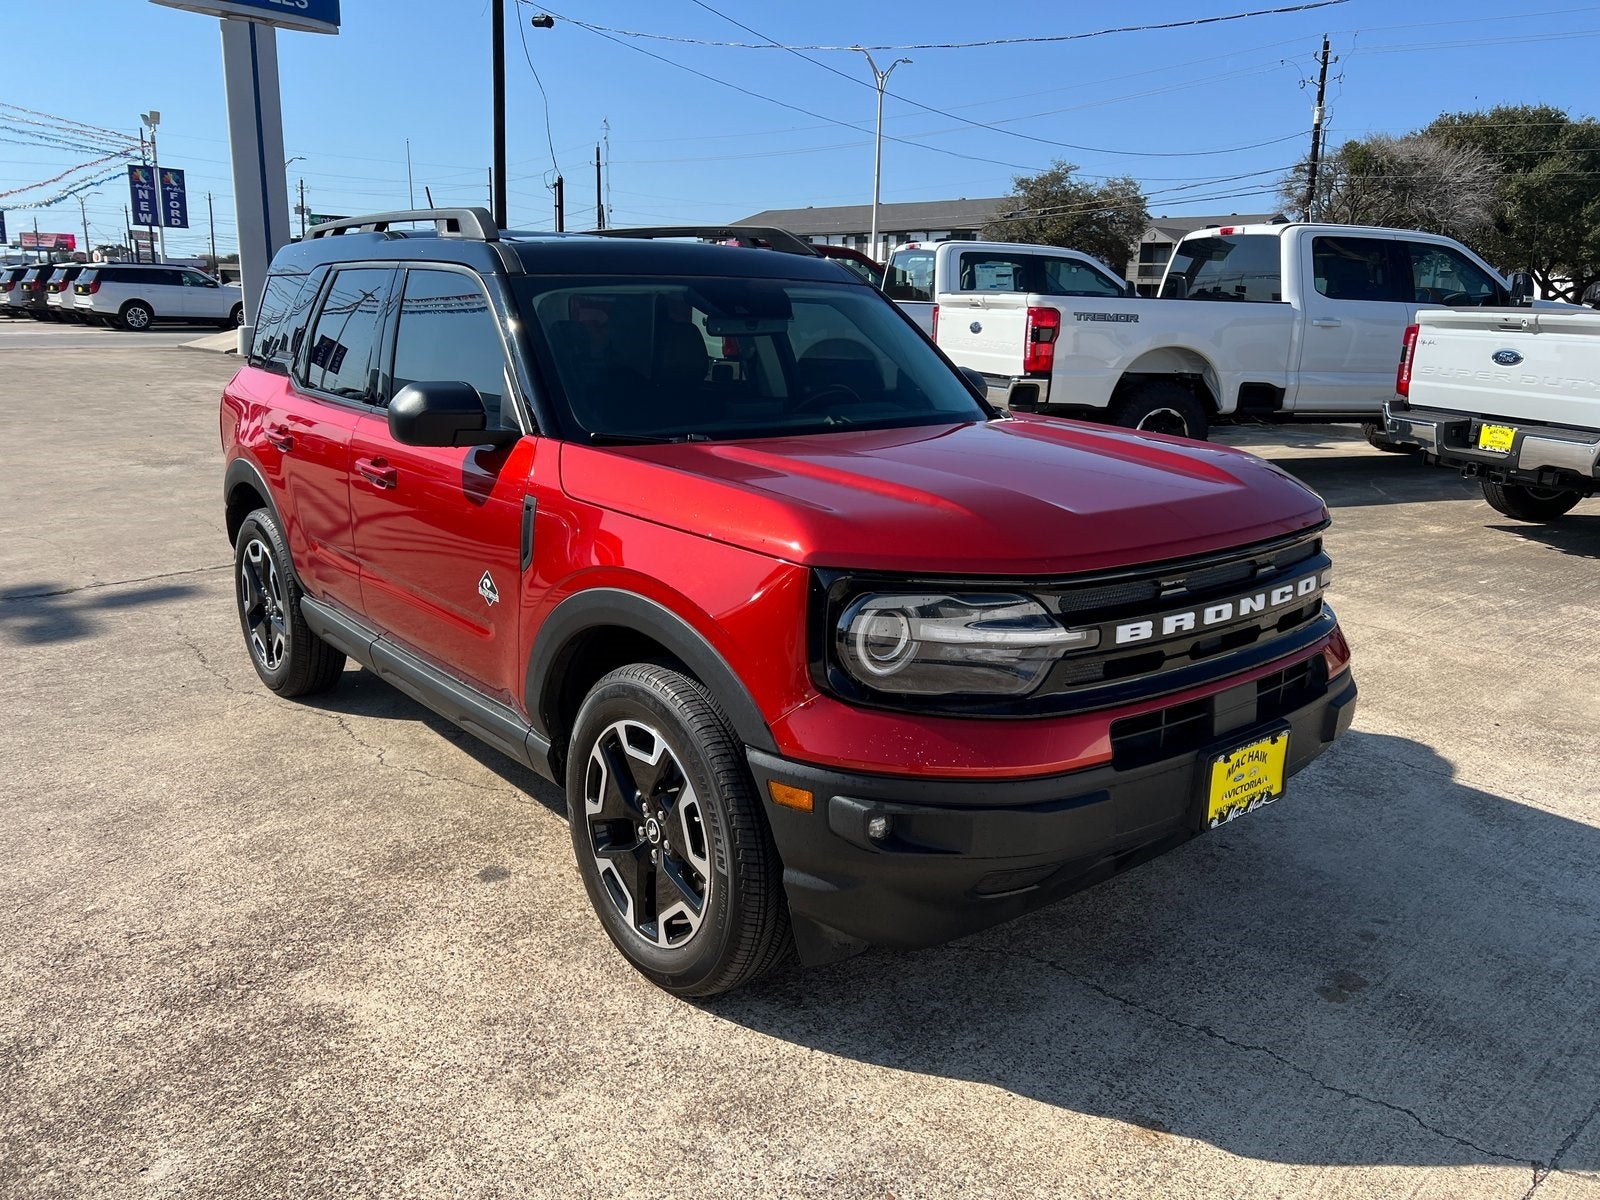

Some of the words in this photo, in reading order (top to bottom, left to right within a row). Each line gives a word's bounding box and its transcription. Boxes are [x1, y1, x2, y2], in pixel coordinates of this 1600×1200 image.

[137, 189, 152, 223] NEW
[169, 191, 181, 226] FORD
[1073, 311, 1140, 323] TREMOR
[1420, 365, 1513, 384] SUPER
[1115, 575, 1317, 644] BRONCO
[1226, 754, 1247, 780] MAC
[1247, 750, 1268, 764] HAIK
[1227, 777, 1262, 799] VICTORIA
[1226, 805, 1247, 823] Mac
[1247, 793, 1273, 814] Haik
